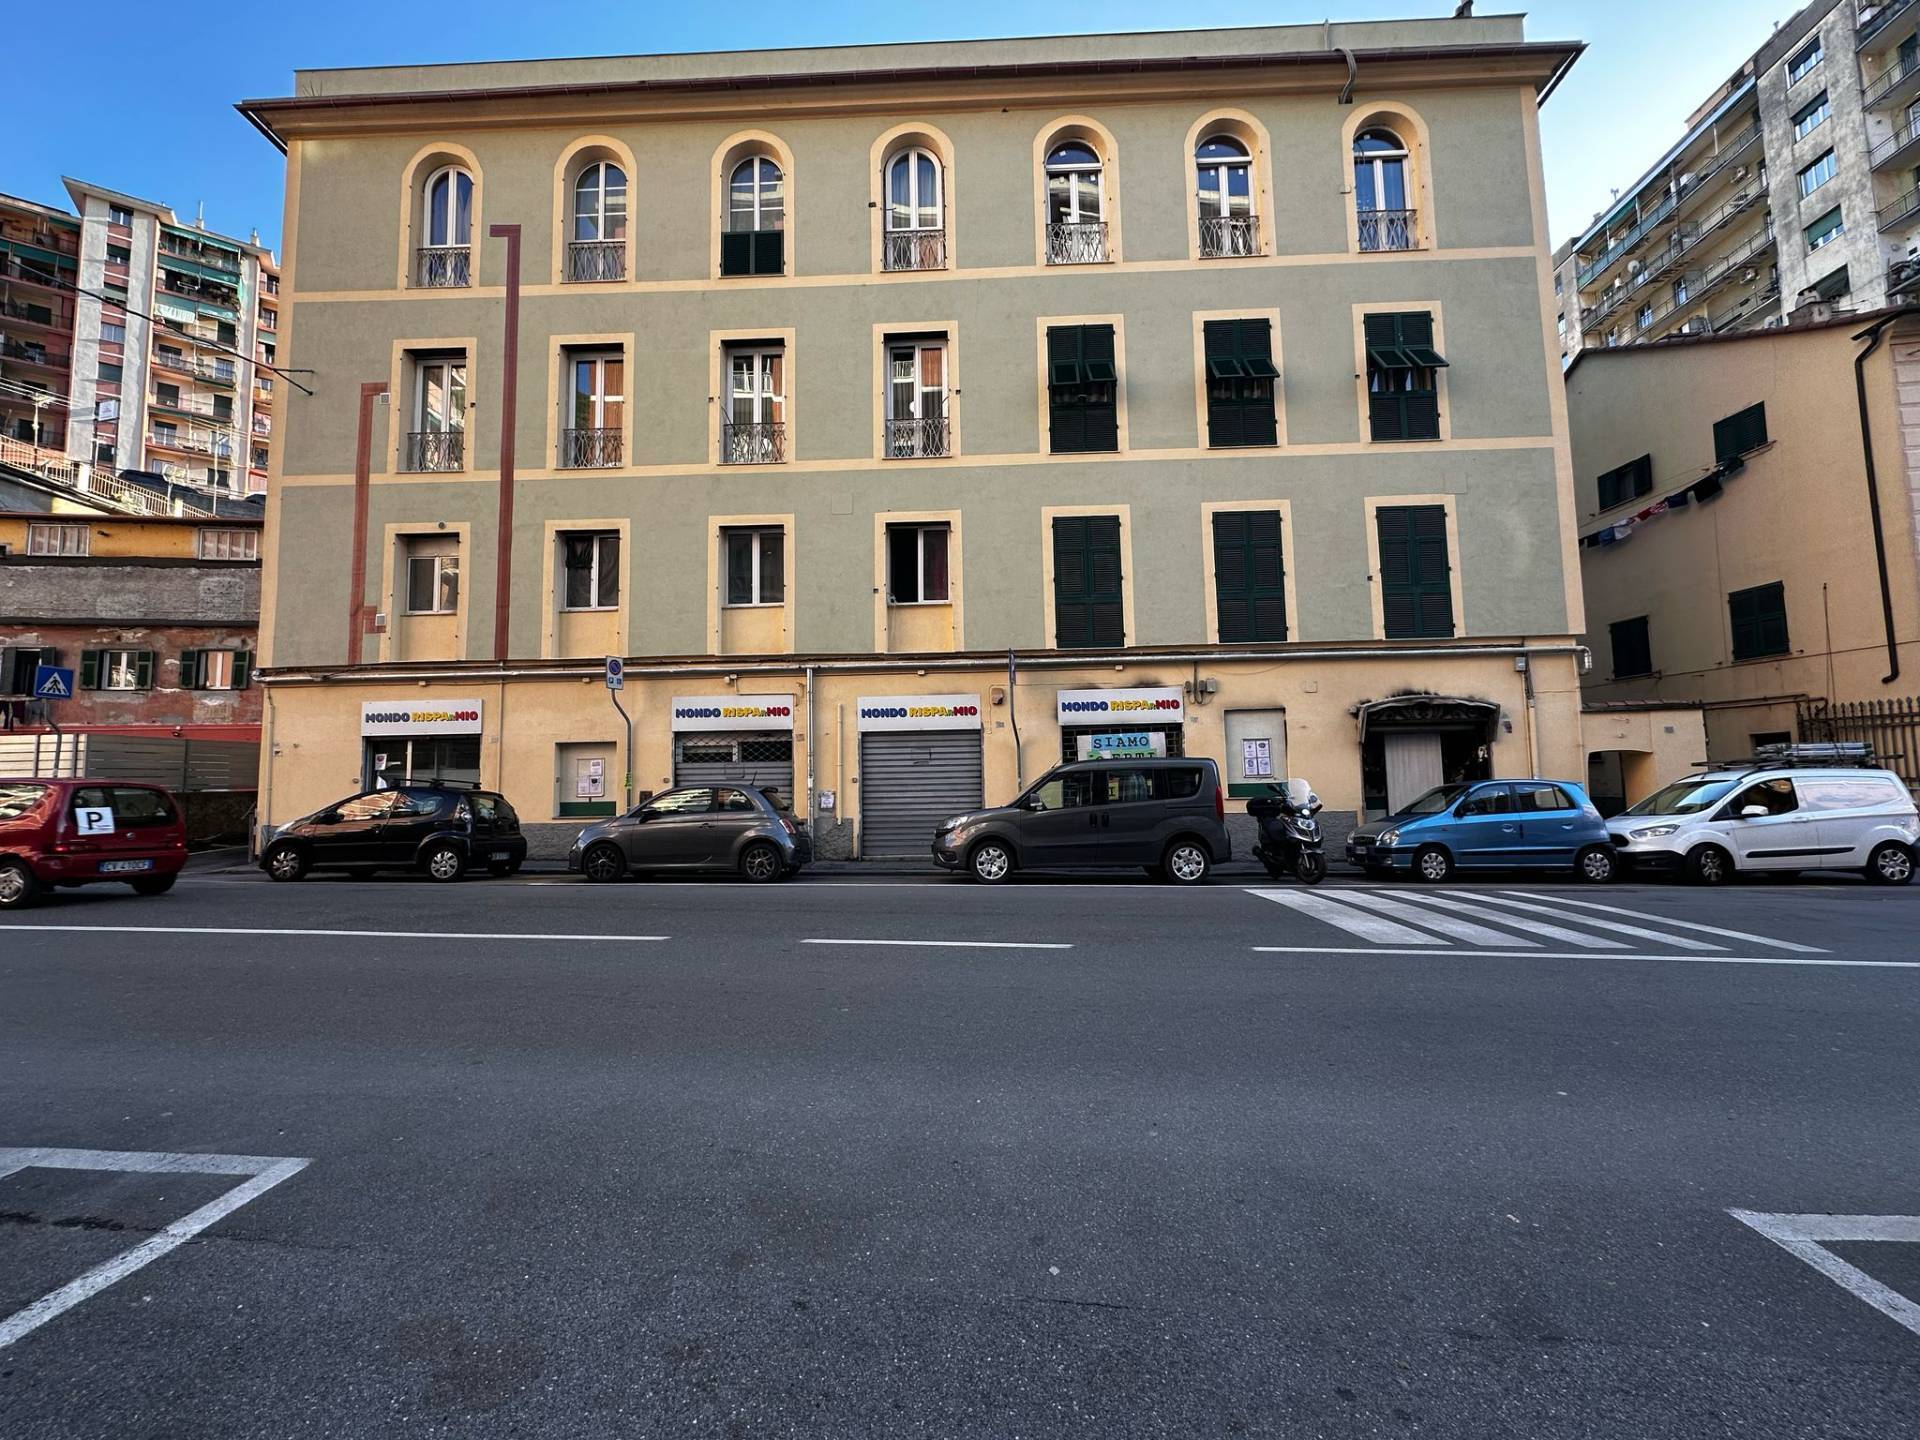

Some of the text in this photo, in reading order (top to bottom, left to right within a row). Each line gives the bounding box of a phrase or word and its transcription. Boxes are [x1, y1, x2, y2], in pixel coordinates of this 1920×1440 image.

[861, 707, 908, 719] MONDO
[1061, 701, 1109, 713] MONDO
[365, 712, 410, 723] MONDO
[675, 708, 721, 719] MONDO
[1093, 736, 1149, 749] SIAMO
[85, 811, 103, 831] P
